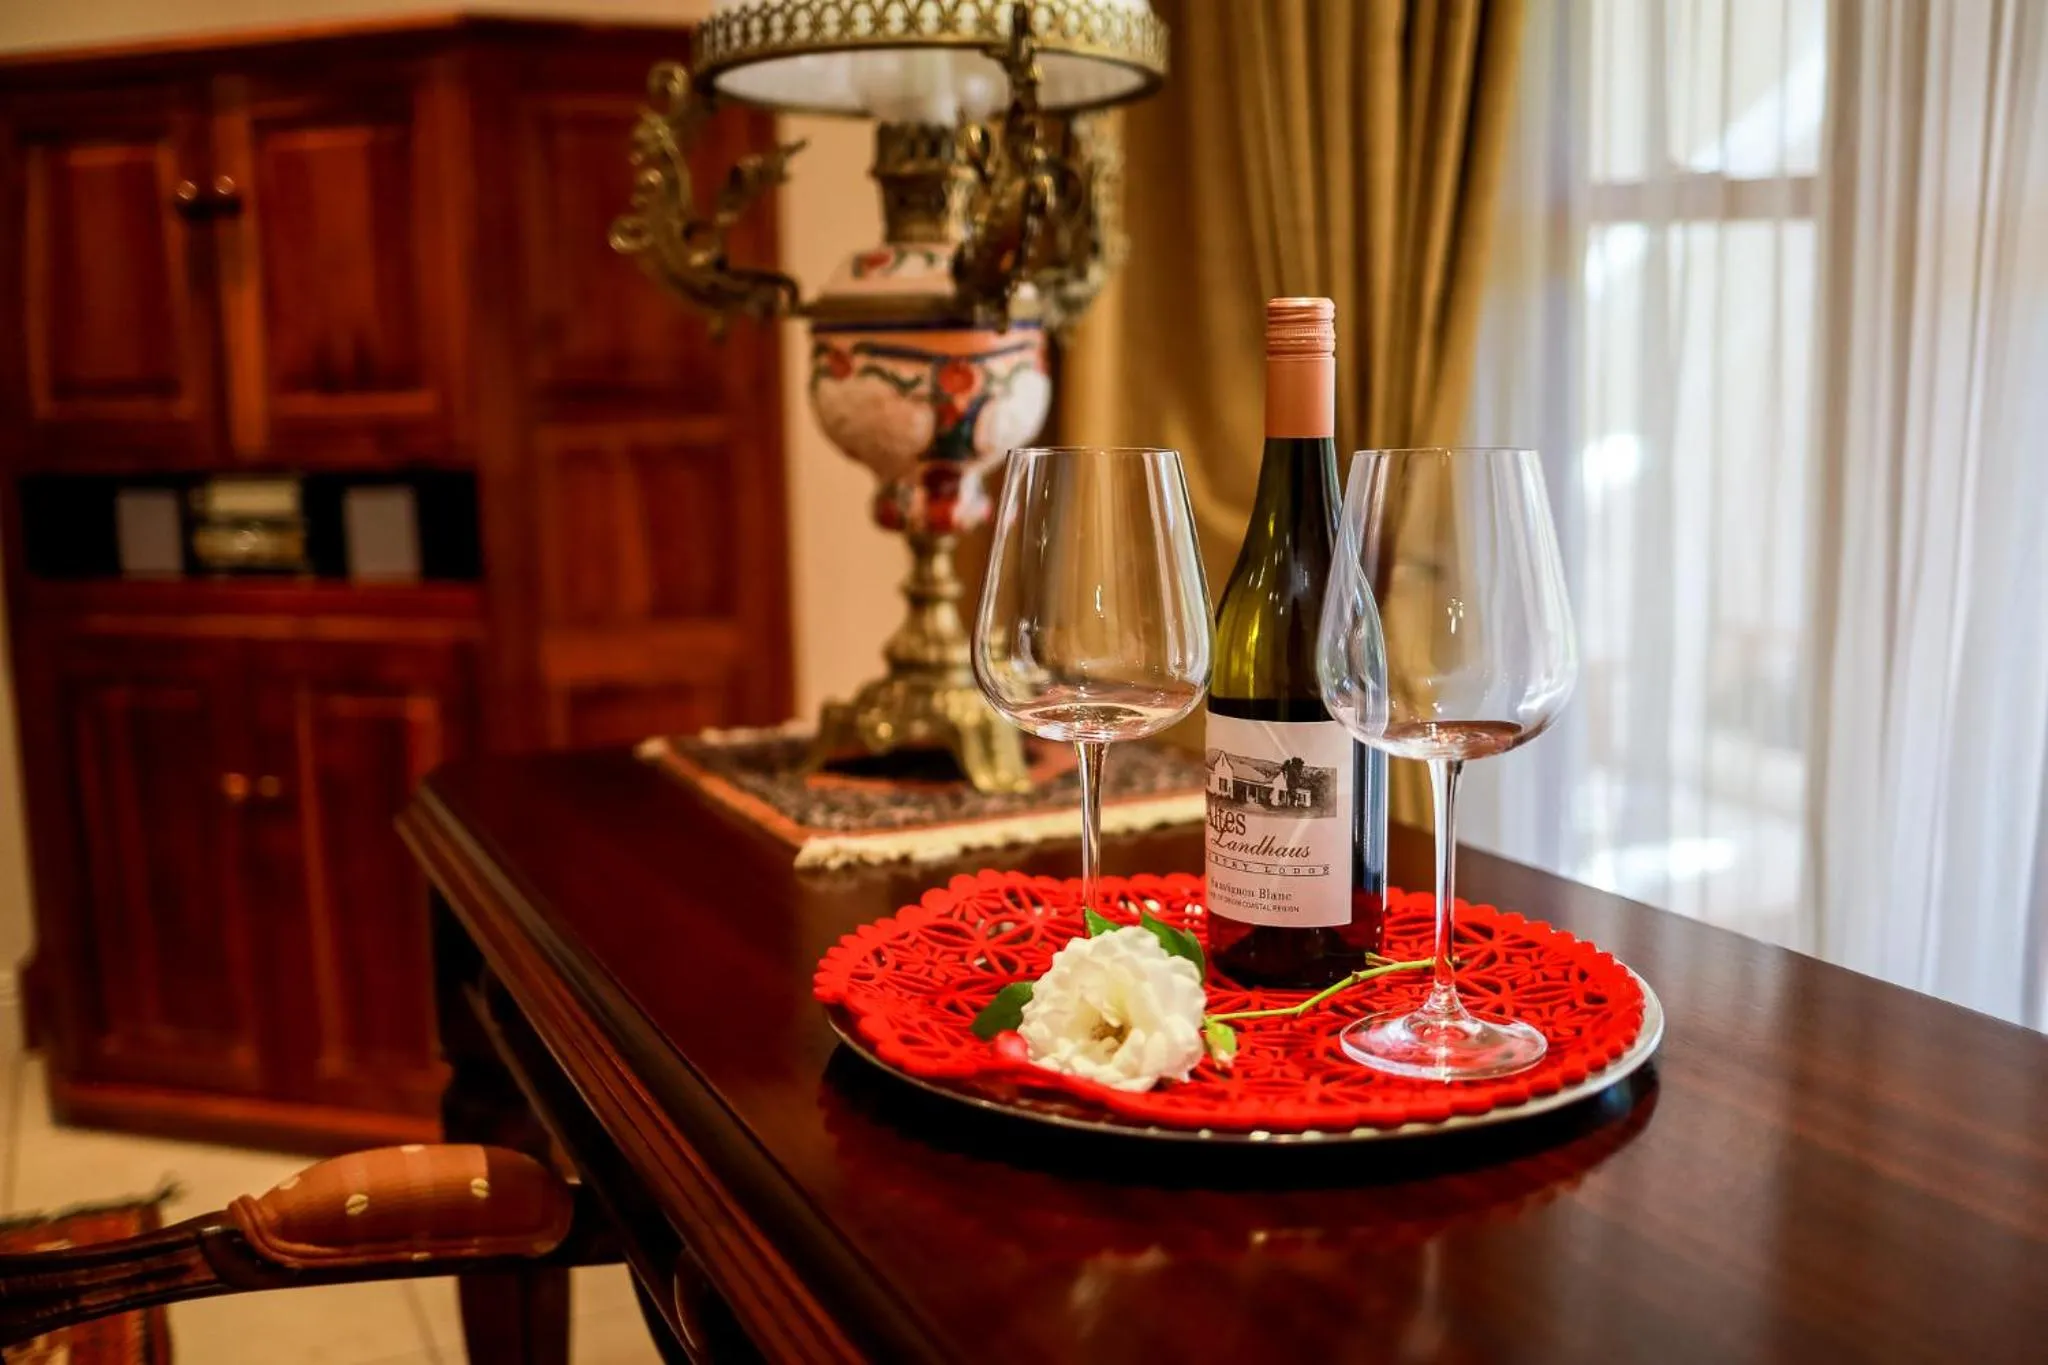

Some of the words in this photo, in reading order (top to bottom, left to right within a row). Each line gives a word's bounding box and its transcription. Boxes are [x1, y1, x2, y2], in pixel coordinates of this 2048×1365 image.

[1211, 834, 1311, 859] Landhaus
[1263, 863, 1330, 876] LODGE
[1258, 887, 1293, 901] Blanc
